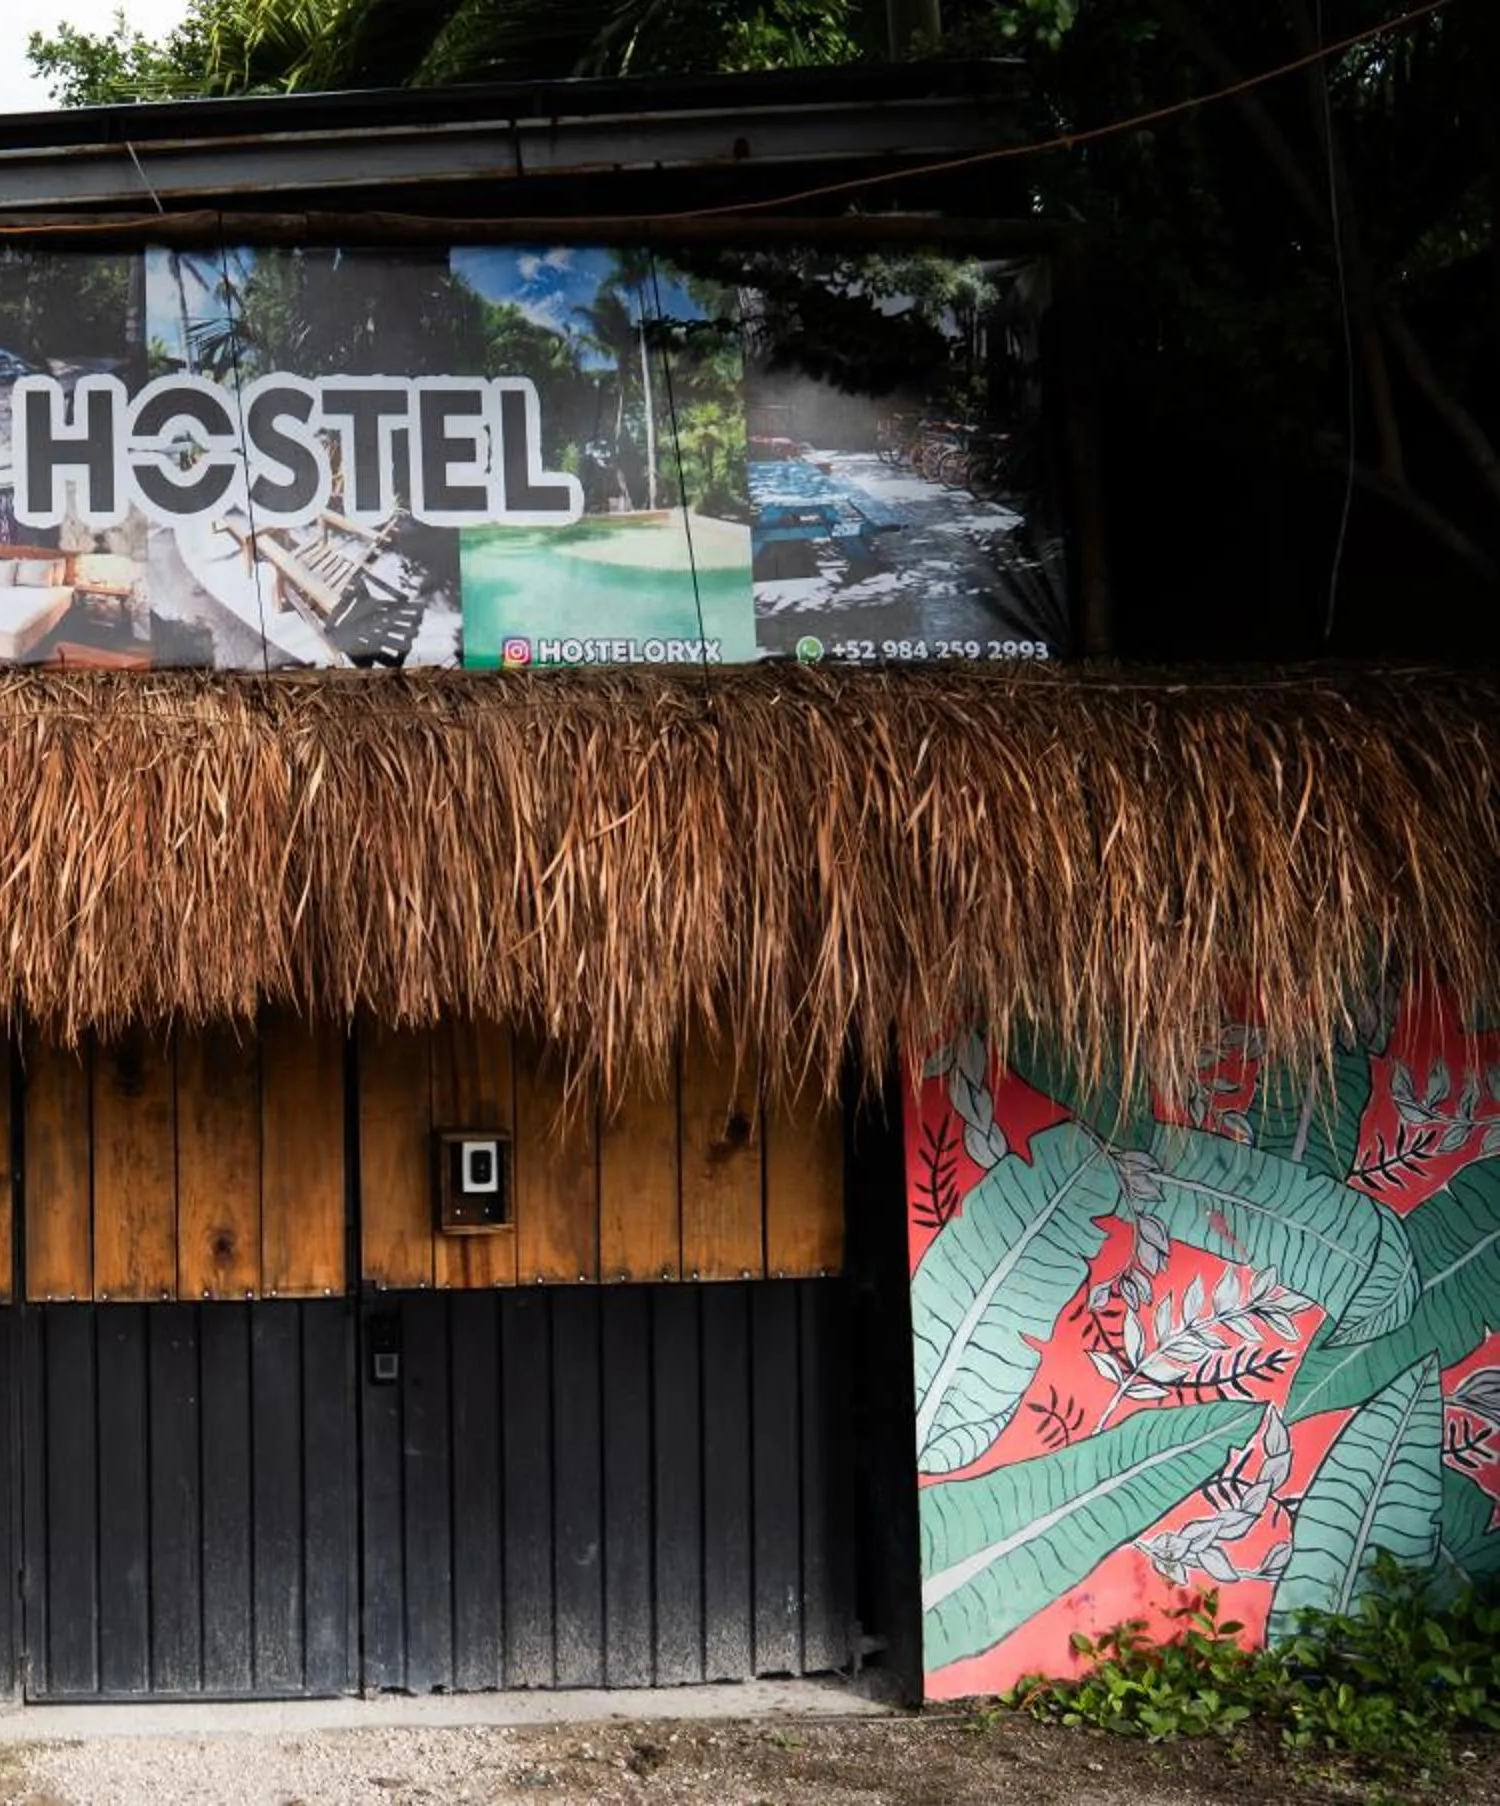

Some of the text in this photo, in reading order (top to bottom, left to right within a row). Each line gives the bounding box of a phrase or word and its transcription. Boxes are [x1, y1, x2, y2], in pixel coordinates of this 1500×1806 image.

[20, 382, 576, 519] HOSTEL
[538, 639, 720, 663] HOSTELORYX
[832, 640, 1049, 660] +52 984 259 2993
